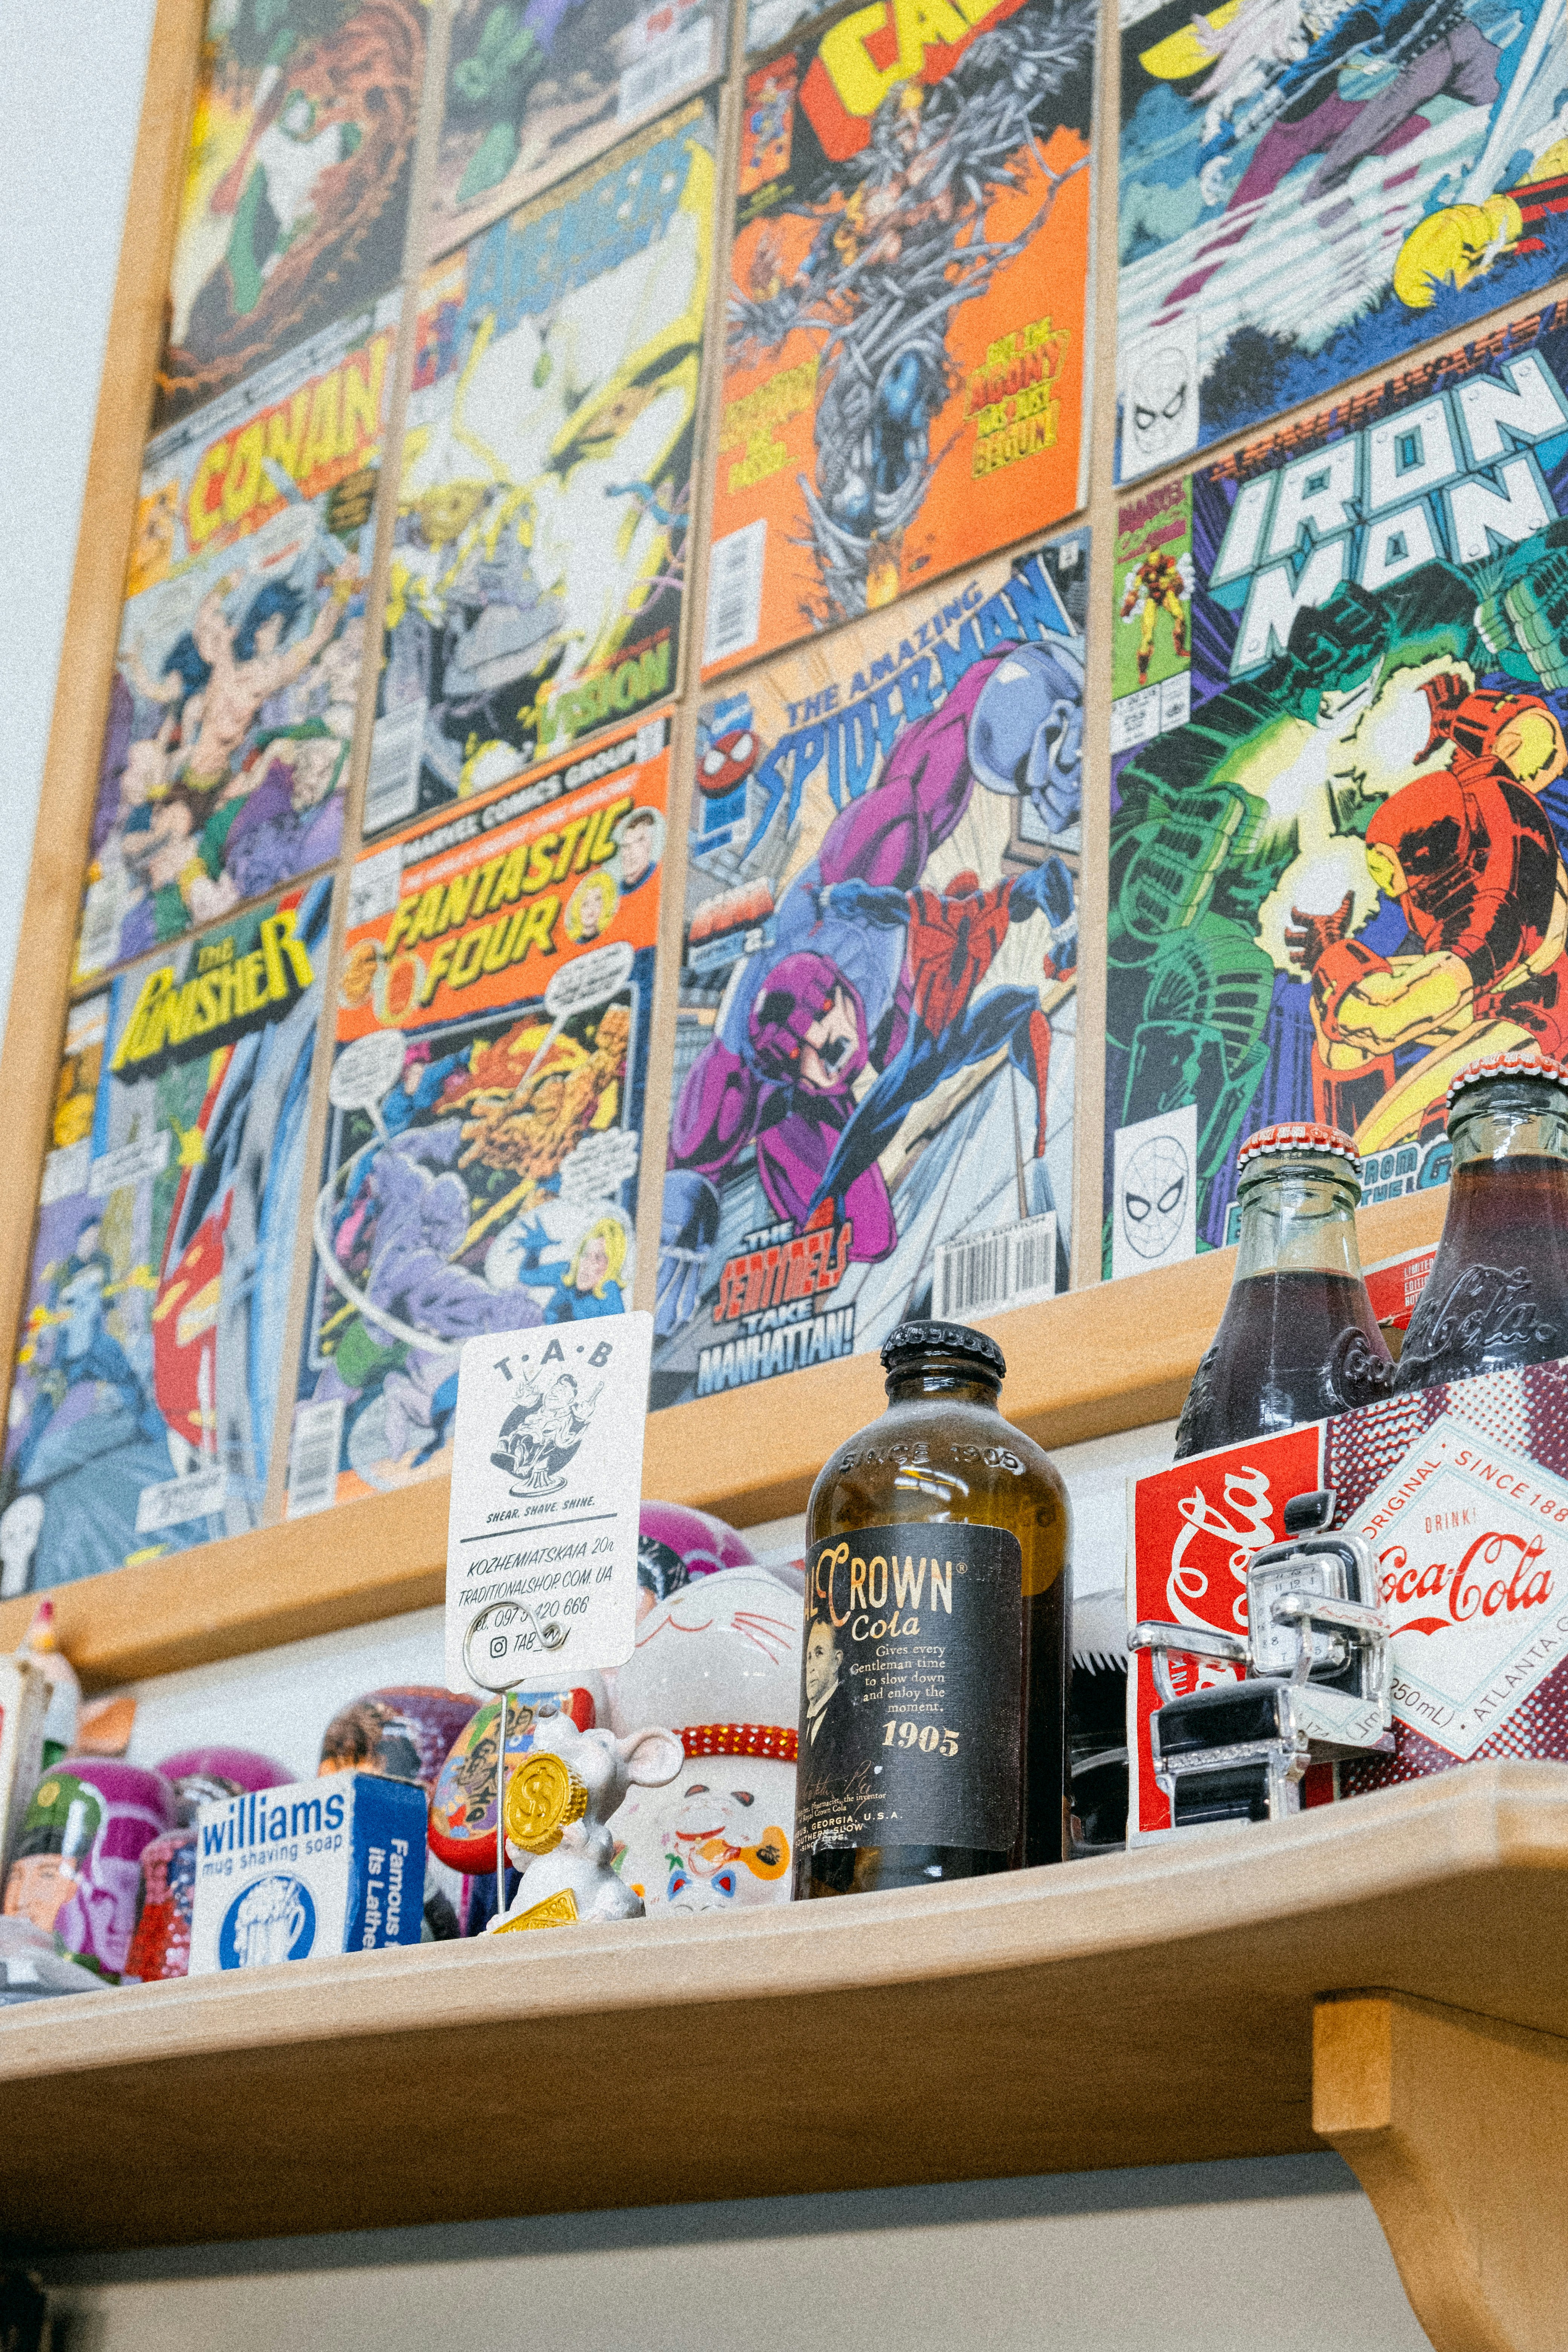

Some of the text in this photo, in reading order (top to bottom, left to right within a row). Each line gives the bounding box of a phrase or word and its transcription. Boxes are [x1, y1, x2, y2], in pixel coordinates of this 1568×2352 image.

[188, 336, 388, 542] CONAN
[1208, 348, 1568, 588] IRON
[787, 684, 838, 726] THE
[850, 580, 983, 699] AMAZING
[403, 816, 481, 864] MARVEL
[482, 776, 562, 828] COMICS
[564, 740, 638, 789] GROUP
[384, 796, 633, 957] FANTASTIC
[419, 894, 562, 1007] FOUR
[743, 1223, 794, 1251] THE
[714, 1222, 852, 1323] SENTINELS
[1404, 1276, 1426, 1292] EDITI
[744, 1299, 813, 1335] TAKE
[697, 1308, 854, 1395] MANHATTAN!
[1454, 1450, 1531, 1499] SINCE
[486, 1496, 595, 1523] SHEAR. SHAVE. SHINE.
[1425, 1507, 1477, 1533] DRINK!
[467, 1542, 587, 1578] KOZHEMIATSKAIA
[564, 1596, 590, 1615] 666
[852, 1610, 920, 1641] Cola
[850, 1656, 945, 1675] Gentleman time
[876, 1644, 946, 1658] Gives every
[863, 1687, 884, 1702] and
[925, 1684, 945, 1697] the
[865, 1671, 945, 1686] to slow down
[888, 1703, 944, 1713] moment.
[882, 1720, 960, 1757] 1905
[203, 1793, 345, 1857] williams
[812, 1815, 858, 1830] GEORGIA,
[863, 1811, 903, 1821] U.S.A.
[833, 1823, 863, 1834] SLOW
[203, 1833, 343, 1876] mug shaving soap
[363, 1846, 385, 1950] its Lathe
[386, 1838, 408, 1936] Famous
